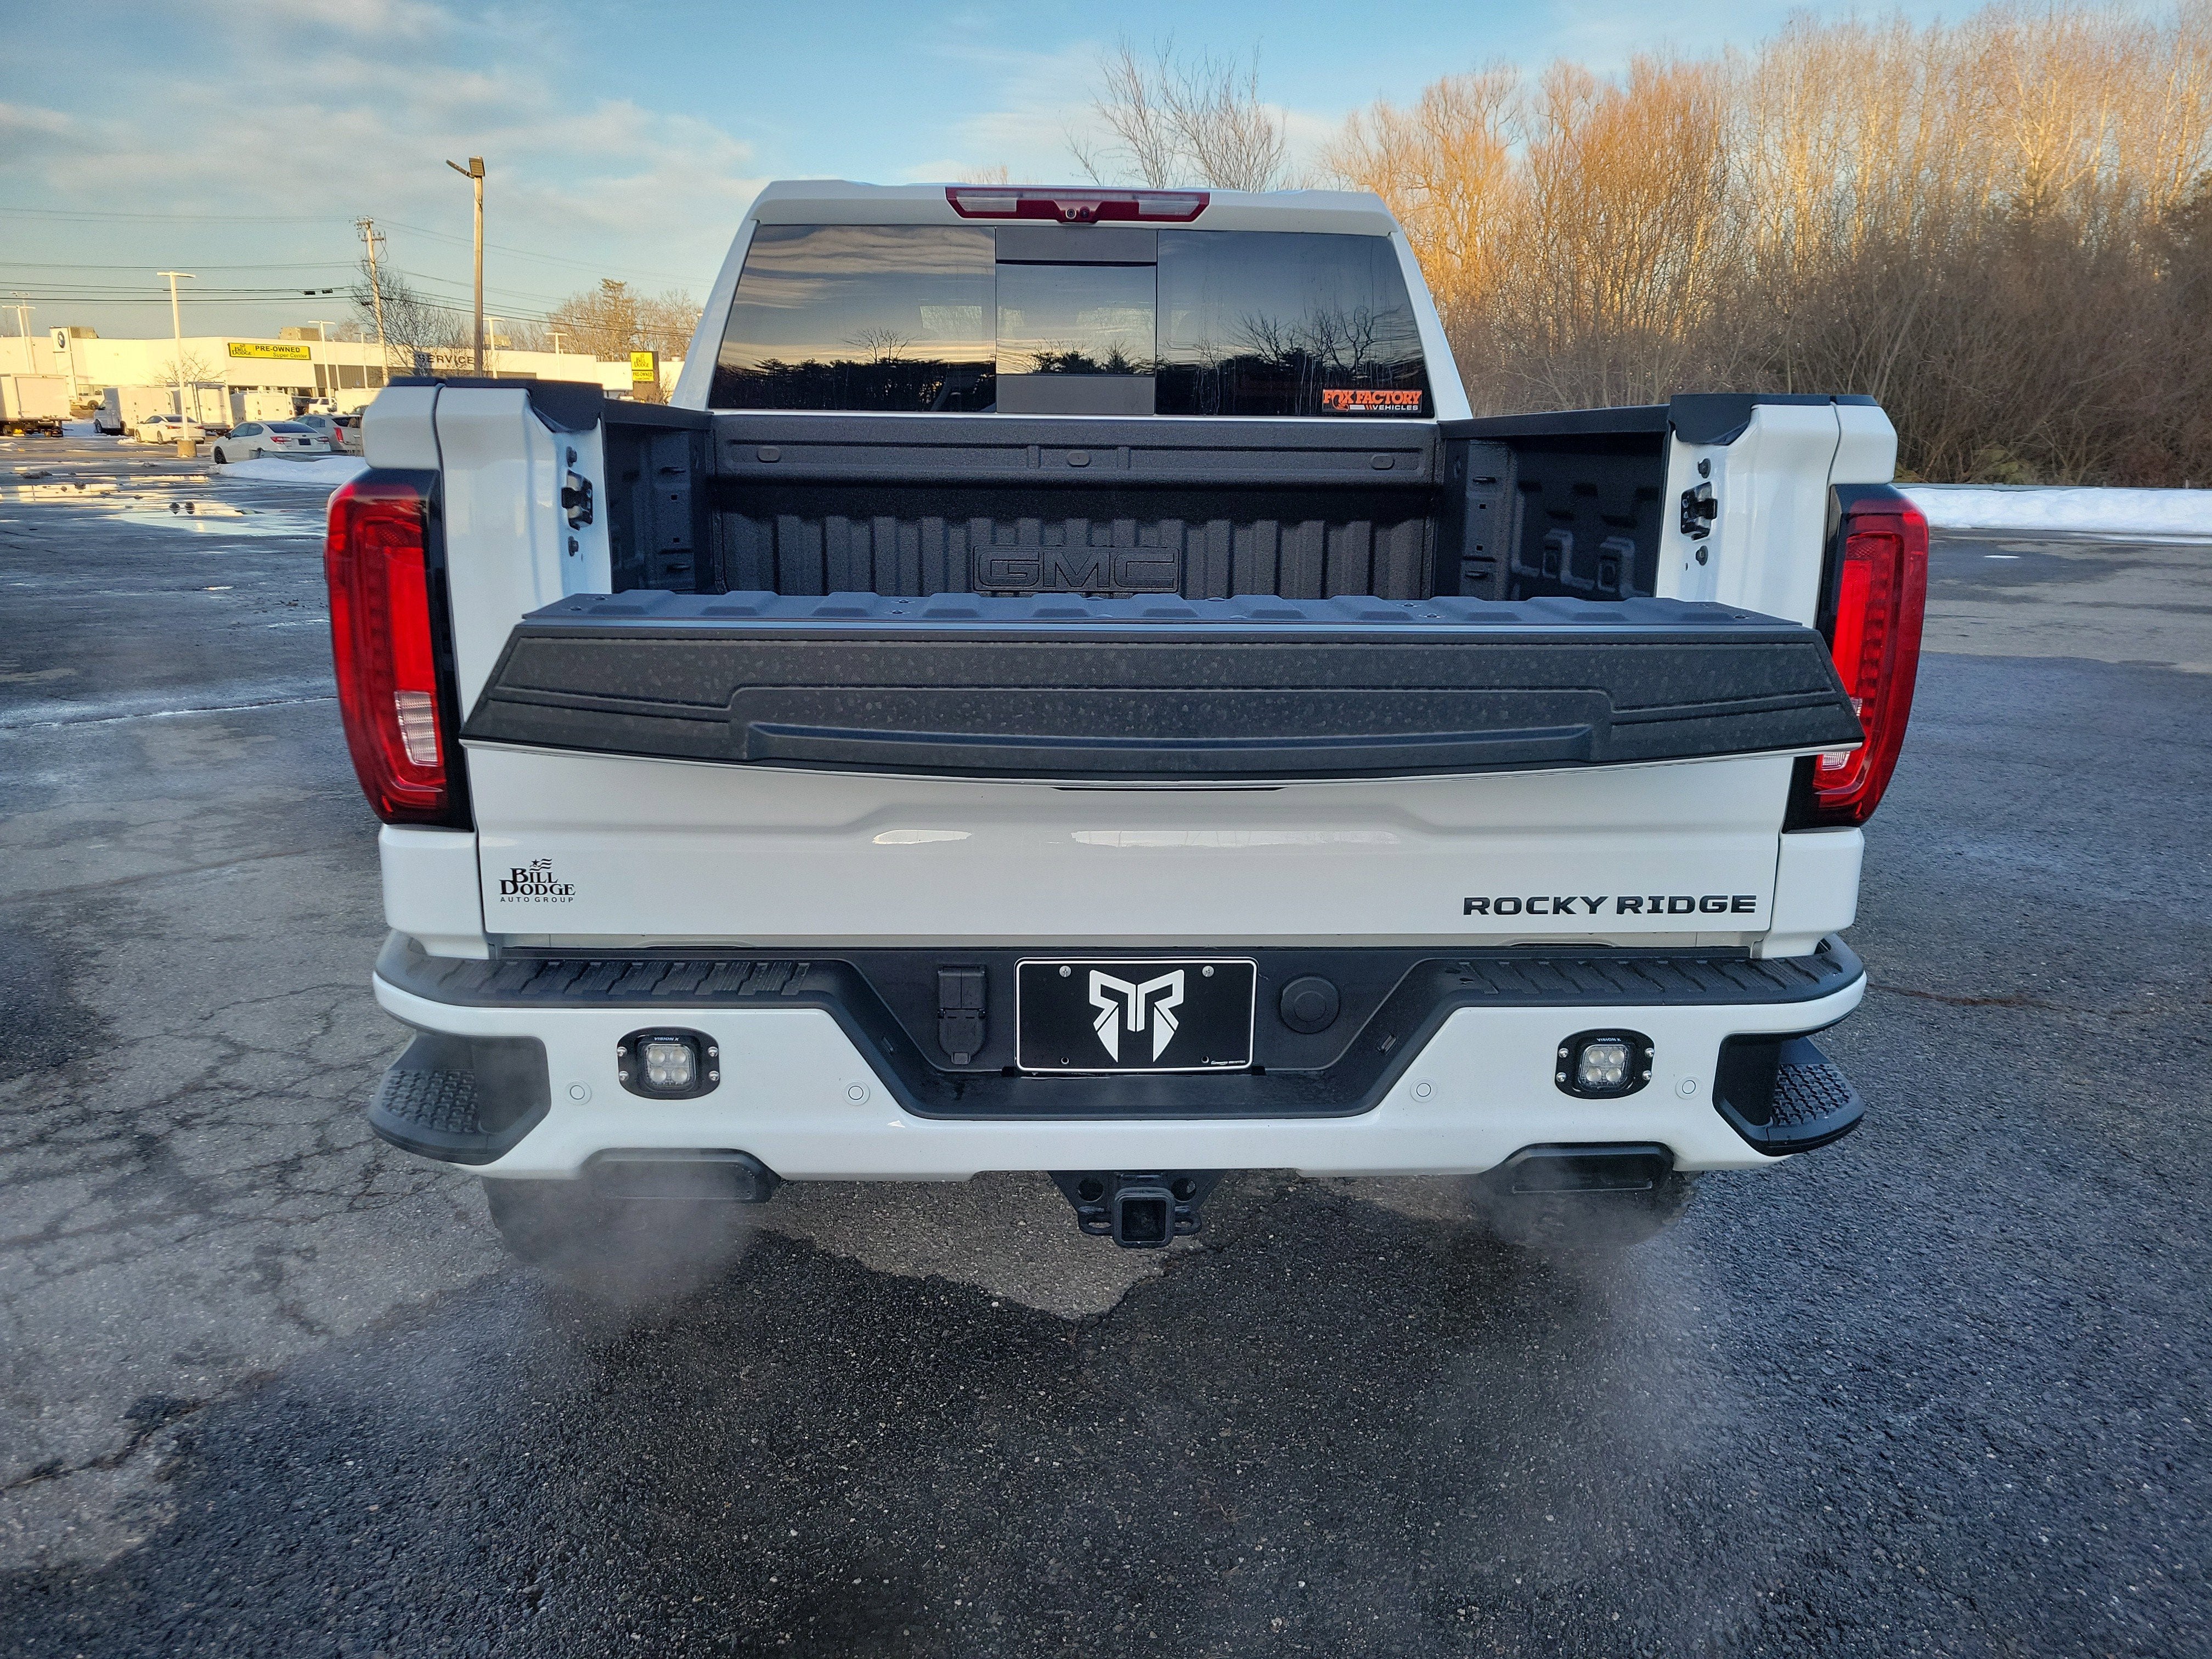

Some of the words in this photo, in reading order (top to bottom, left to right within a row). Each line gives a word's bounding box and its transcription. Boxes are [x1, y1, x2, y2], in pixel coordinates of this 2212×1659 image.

[418, 354, 475, 364] SERVICE
[1323, 390, 1354, 407] FOX
[1356, 391, 1421, 404] FACTORY
[978, 550, 1175, 588] GMC
[510, 867, 558, 883] BILL
[499, 879, 575, 895] DODGE
[1463, 896, 1609, 915] ROCKY
[1616, 895, 1757, 915] RIDGE
